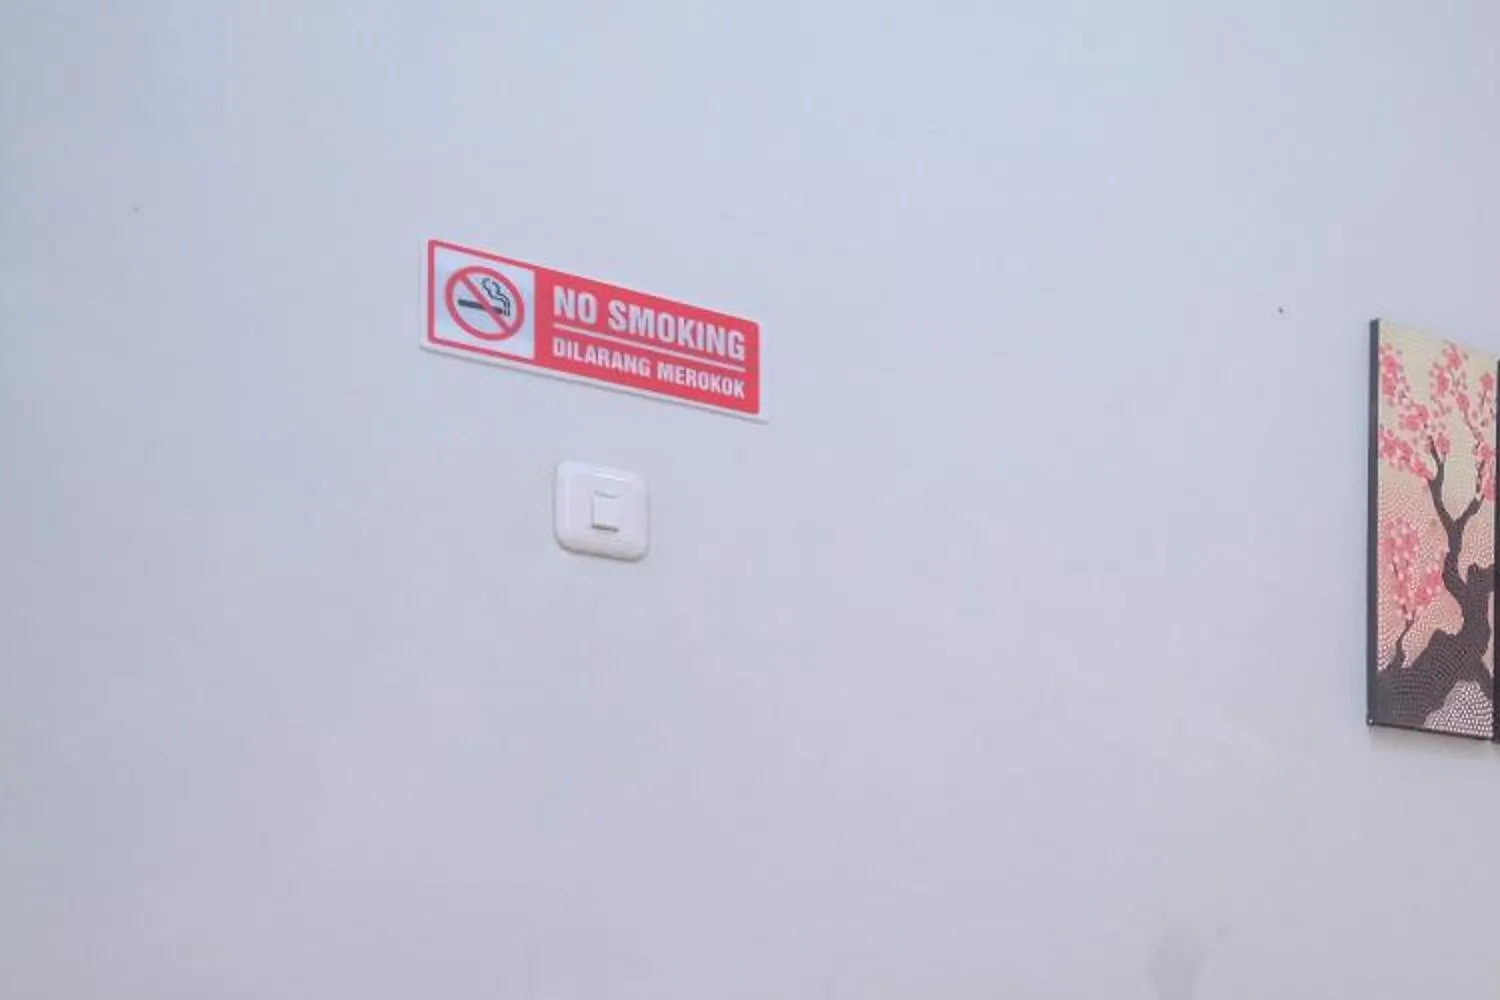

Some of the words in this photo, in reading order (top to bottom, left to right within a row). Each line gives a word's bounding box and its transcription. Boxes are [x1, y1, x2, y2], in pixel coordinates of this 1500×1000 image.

[553, 286, 597, 325] NO
[608, 300, 746, 361] SMOKING
[553, 337, 651, 378] DILARANG
[657, 362, 746, 399] MEROKOK
